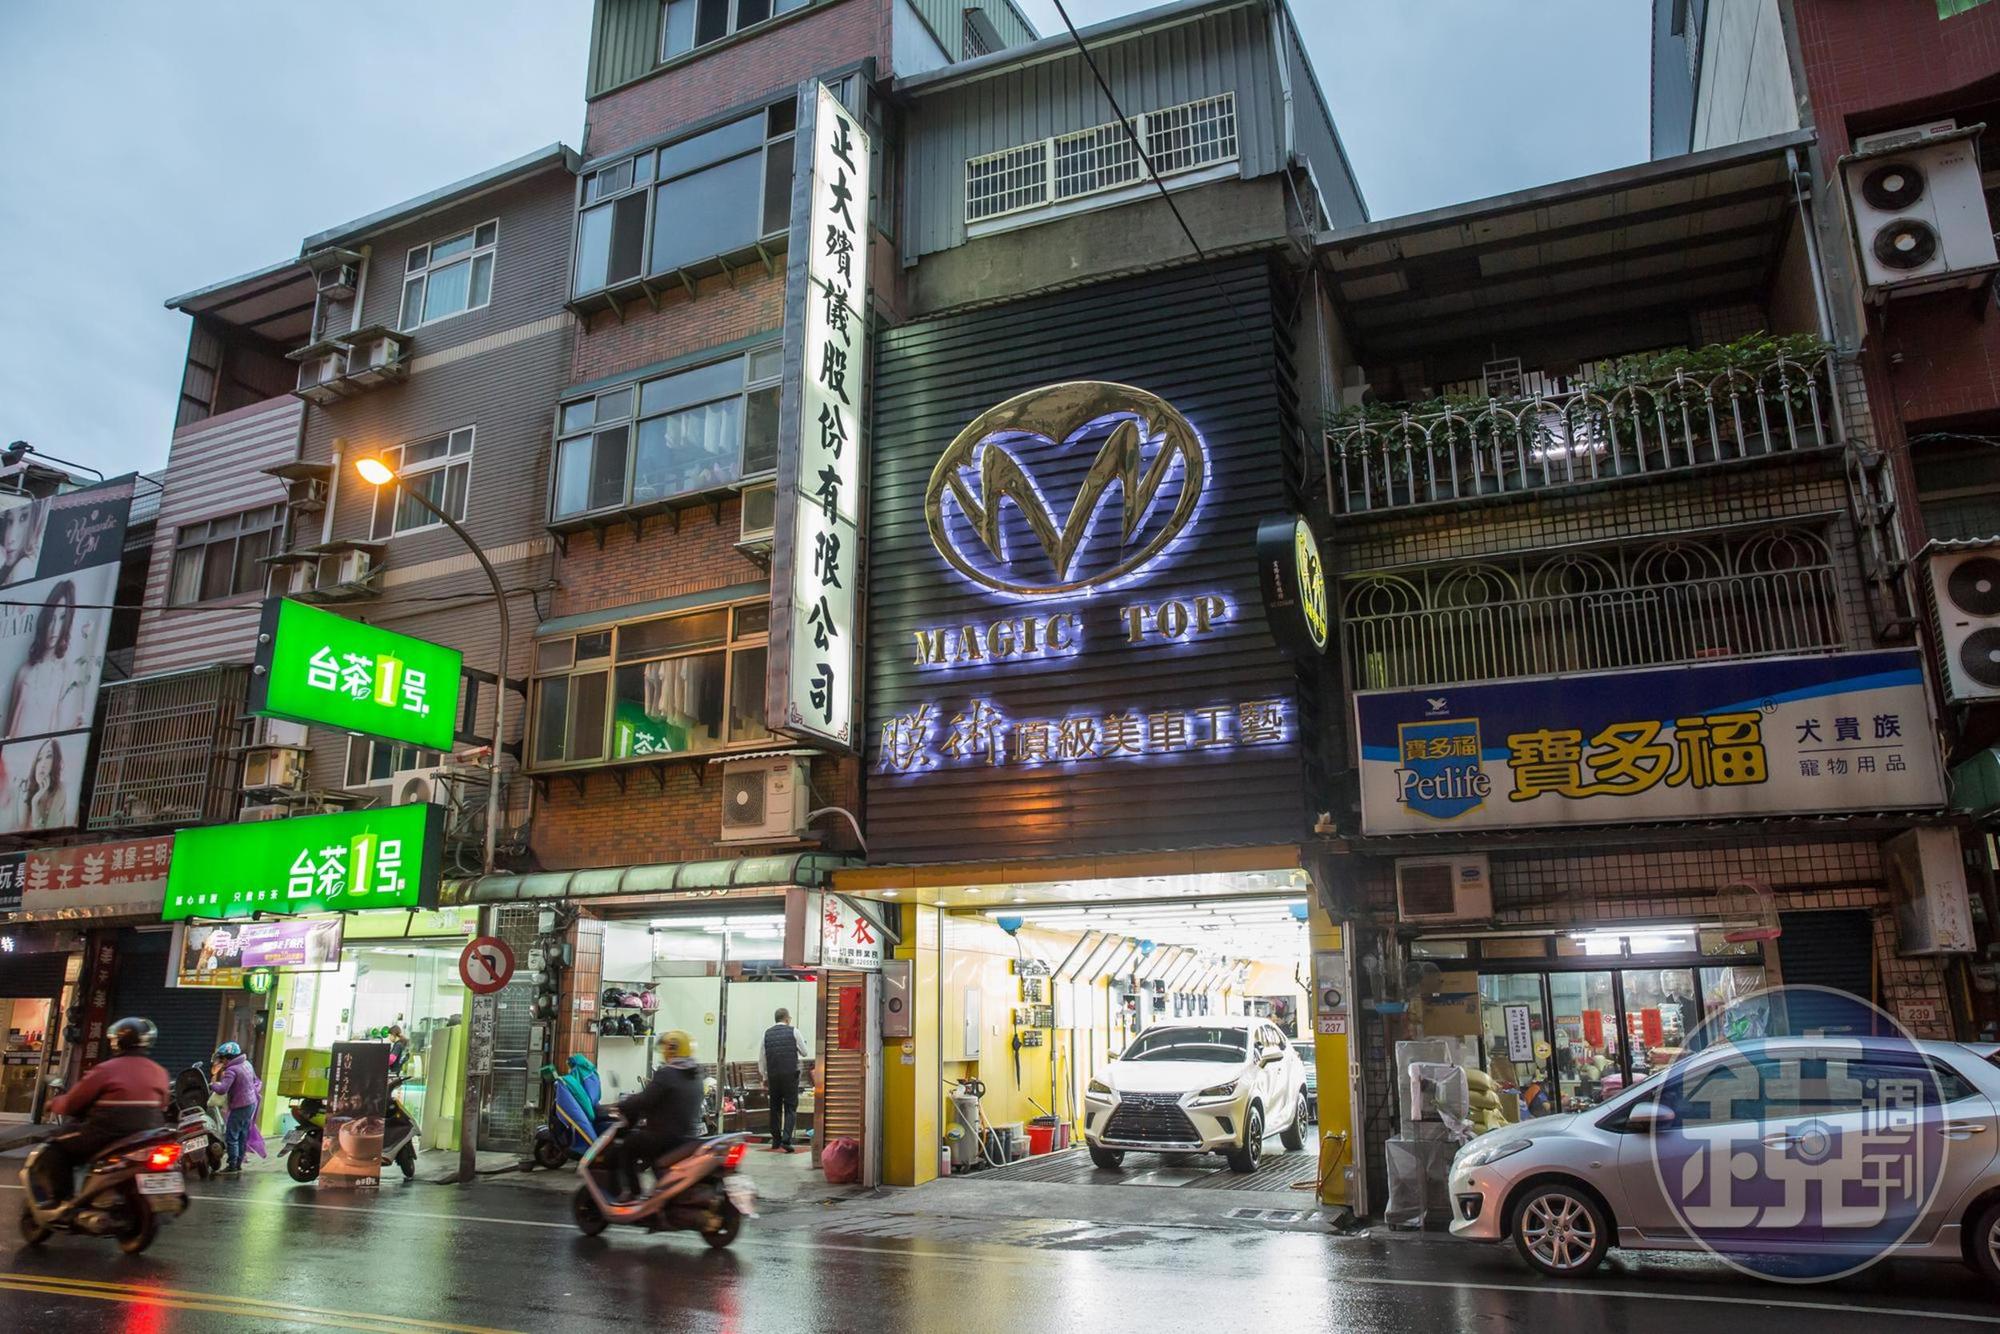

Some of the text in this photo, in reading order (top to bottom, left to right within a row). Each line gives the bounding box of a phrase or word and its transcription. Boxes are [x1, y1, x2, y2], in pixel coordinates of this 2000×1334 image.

[808, 114, 856, 725] 正大殯儀股份有限公司
[914, 595, 1227, 666] MAGIC TOP
[307, 645, 429, 714] 台茶1号
[1405, 735, 1478, 760] 寶多福
[1796, 714, 1903, 745] 犬貴族
[1506, 710, 1769, 802] 寶多福
[1799, 754, 1907, 778] 寵物用品
[1394, 765, 1491, 802] Petlife
[287, 838, 403, 899] 台茶1号
[1324, 1022, 1341, 1033] 237
[1909, 1008, 1930, 1020] 239
